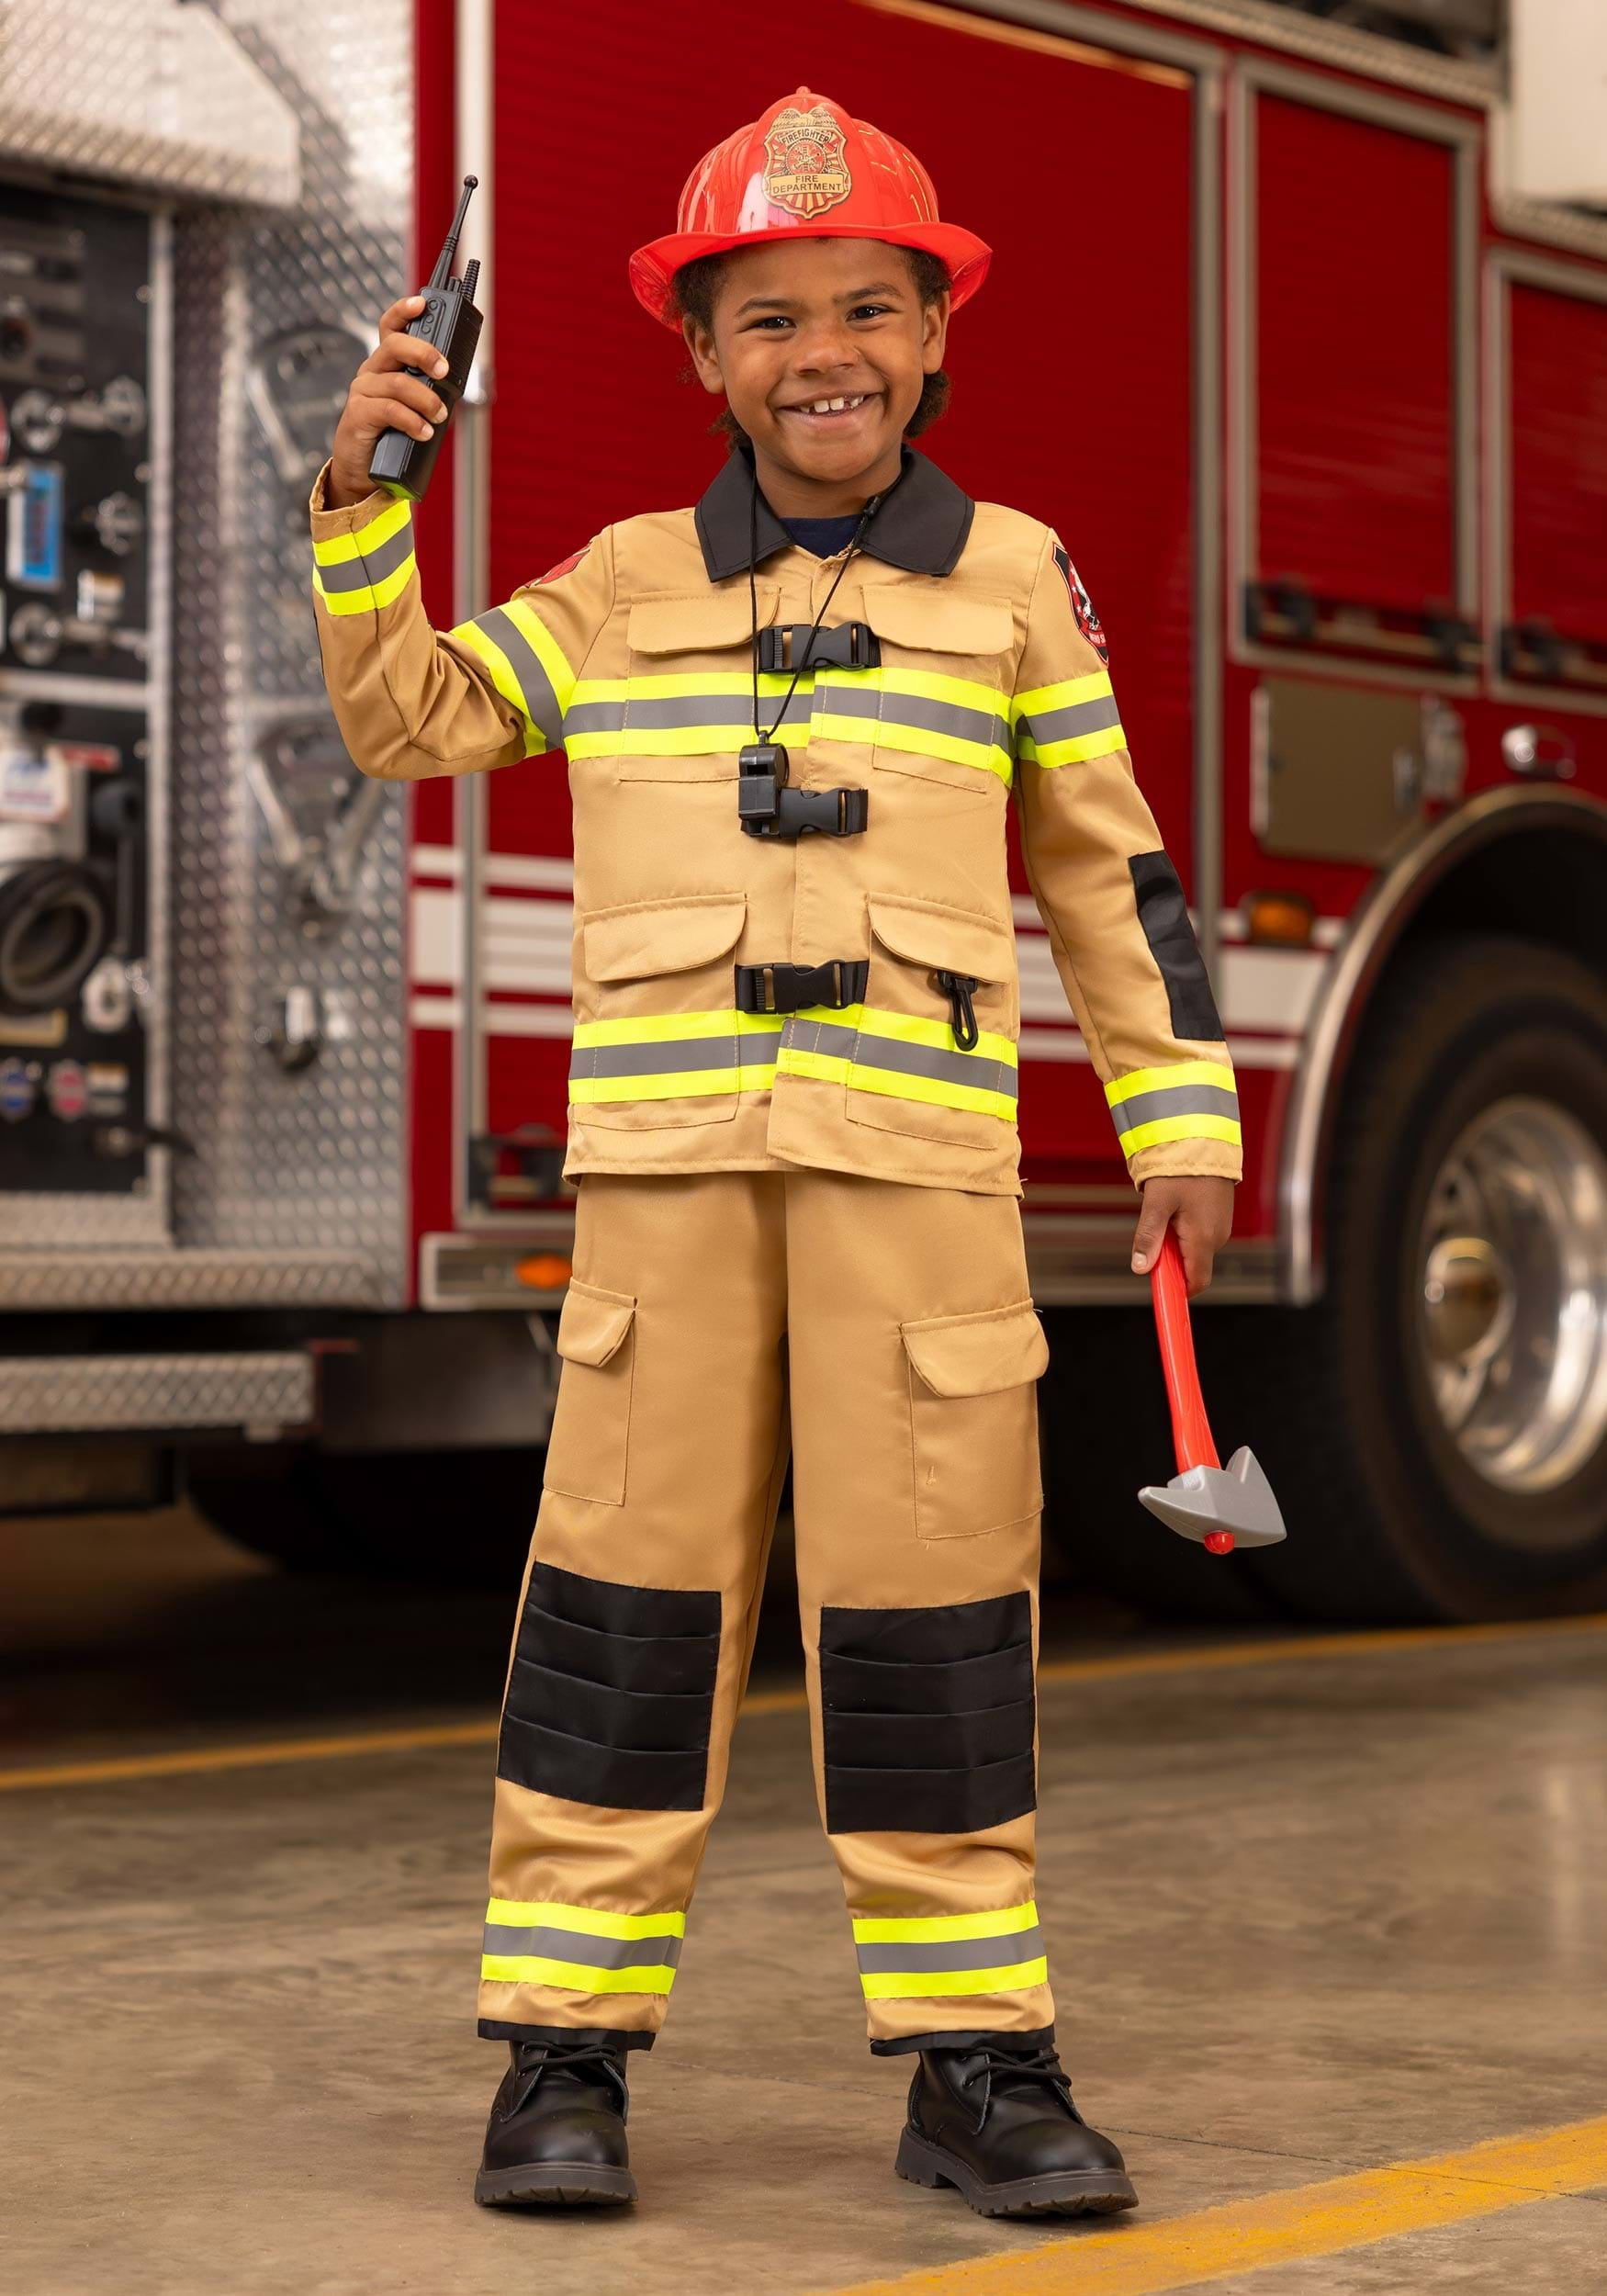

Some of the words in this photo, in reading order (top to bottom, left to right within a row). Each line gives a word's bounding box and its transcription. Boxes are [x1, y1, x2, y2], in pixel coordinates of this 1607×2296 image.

[781, 128, 830, 144] FIREFIGHTER
[795, 174, 819, 183] FIRE
[772, 183, 842, 195] DEPARTMENT
